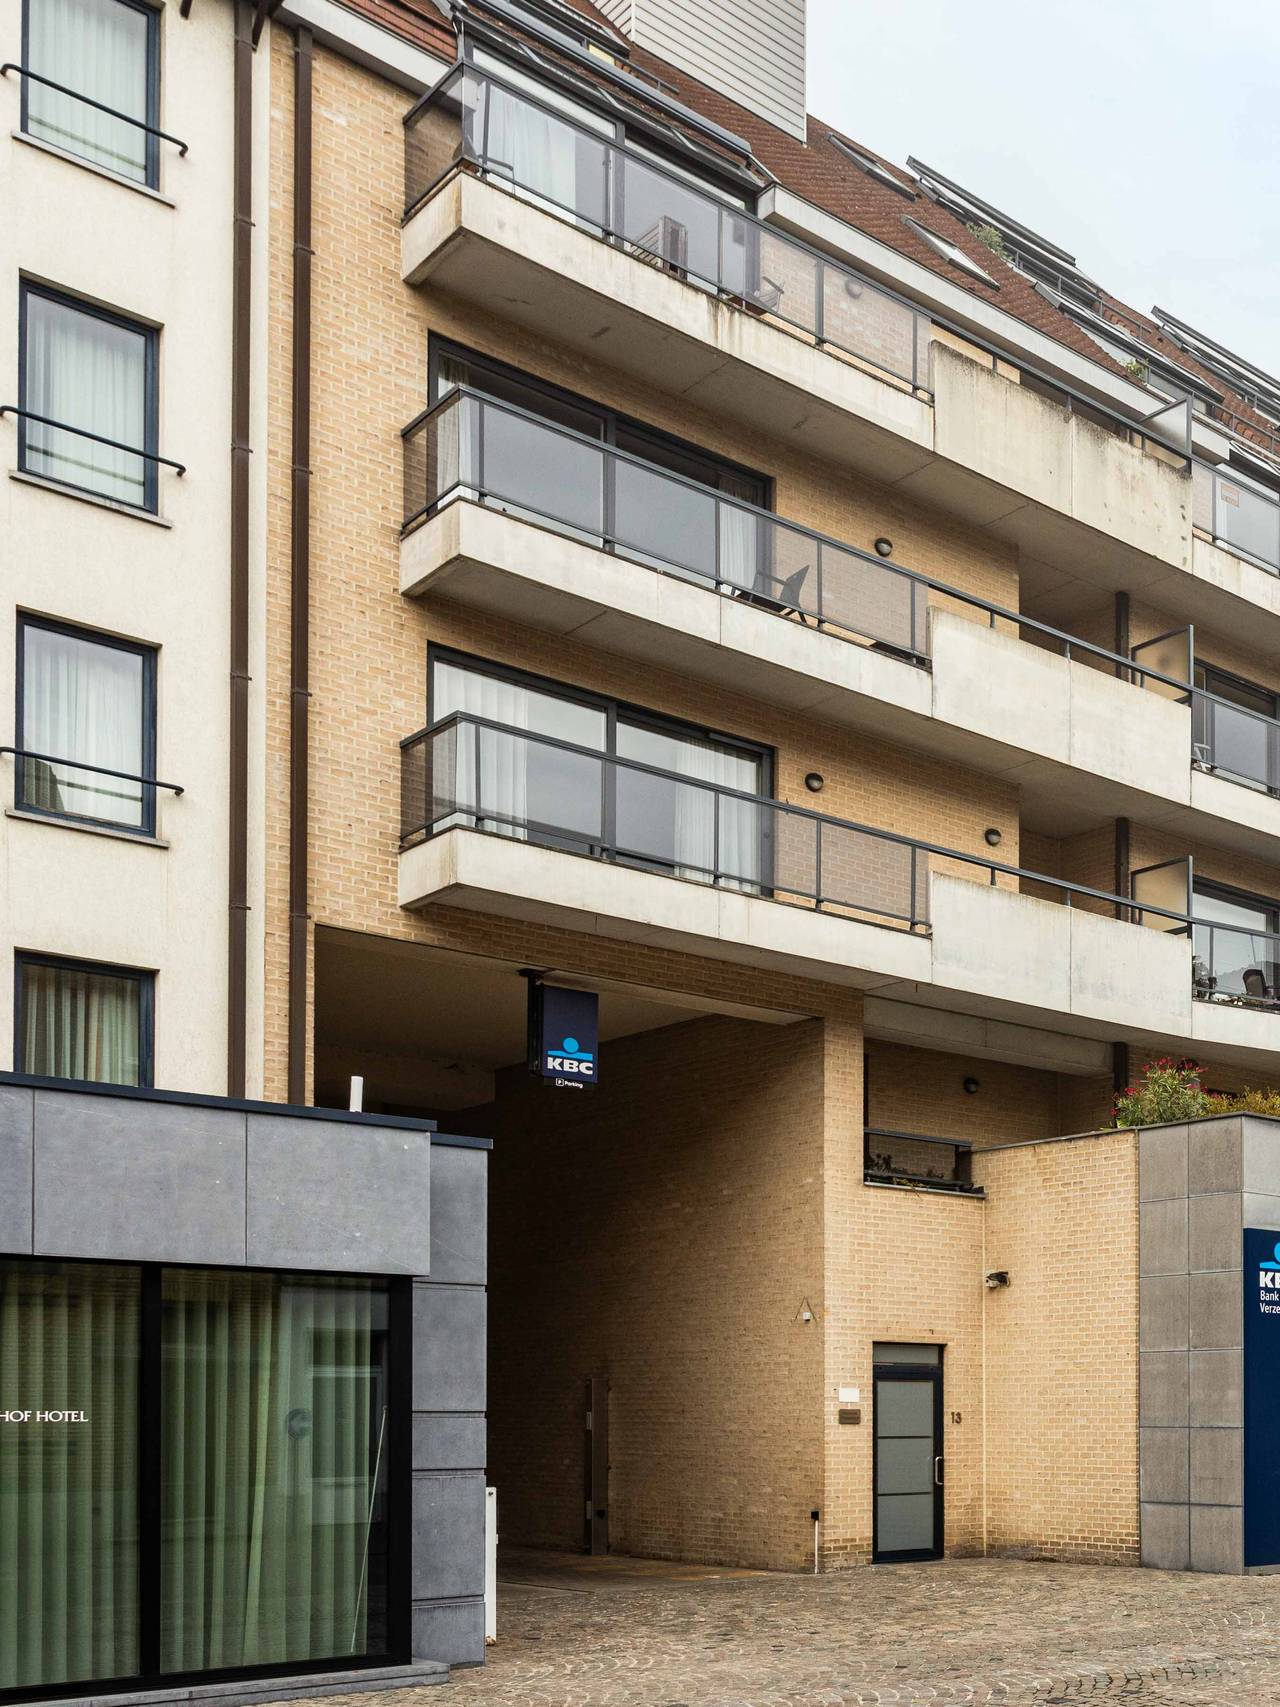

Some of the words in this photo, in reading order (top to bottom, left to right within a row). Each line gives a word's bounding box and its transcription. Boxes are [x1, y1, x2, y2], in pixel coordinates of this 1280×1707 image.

[547, 1056, 593, 1075] KBC
[564, 1080, 583, 1089] Parking
[1260, 1290, 1279, 1301] Bank
[0, 1410, 32, 1422] HOF
[36, 1410, 89, 1422] HOTEL
[951, 1411, 962, 1424] 13
